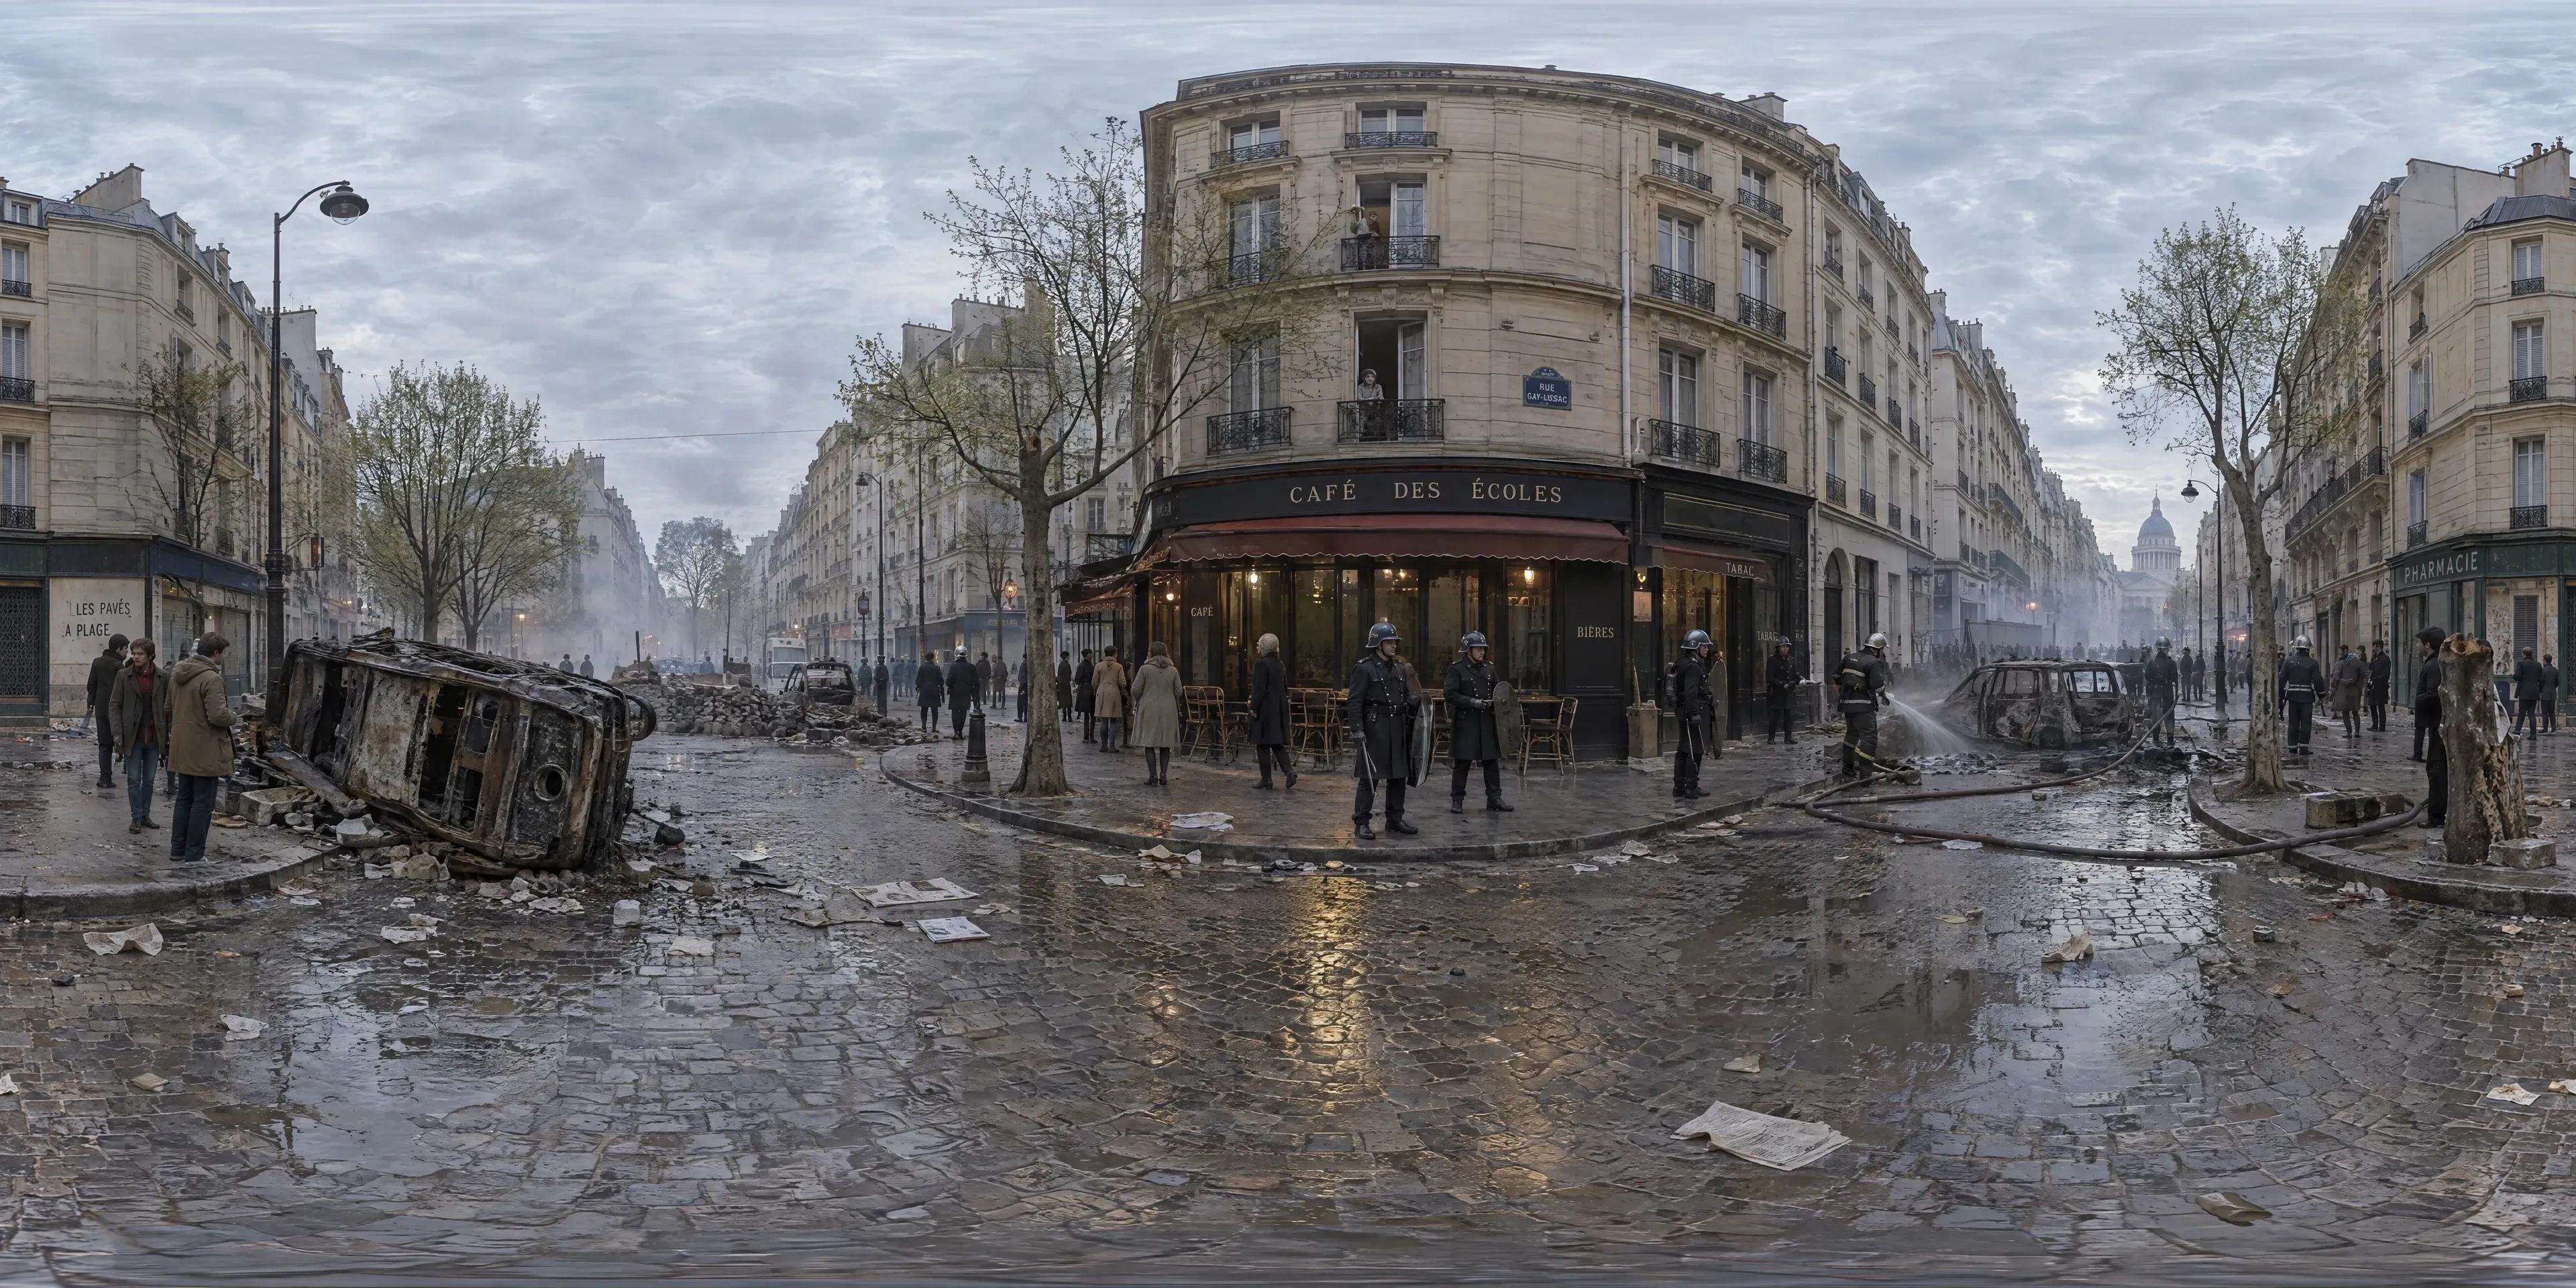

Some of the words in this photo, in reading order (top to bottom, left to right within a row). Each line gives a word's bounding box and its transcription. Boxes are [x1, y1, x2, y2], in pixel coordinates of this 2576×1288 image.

[1540, 383, 1555, 392] RUE
[1290, 479, 1356, 504] CAFÉ
[1394, 482, 1440, 499] DES
[1472, 478, 1562, 503] ÉCOLES
[1725, 562, 1754, 576] TABAC
[2405, 551, 2477, 584] PHARMACIE
[76, 602, 94, 615] LES
[100, 598, 130, 615] PAVÉS
[65, 624, 71, 637] A
[77, 623, 111, 636] PLAGE
